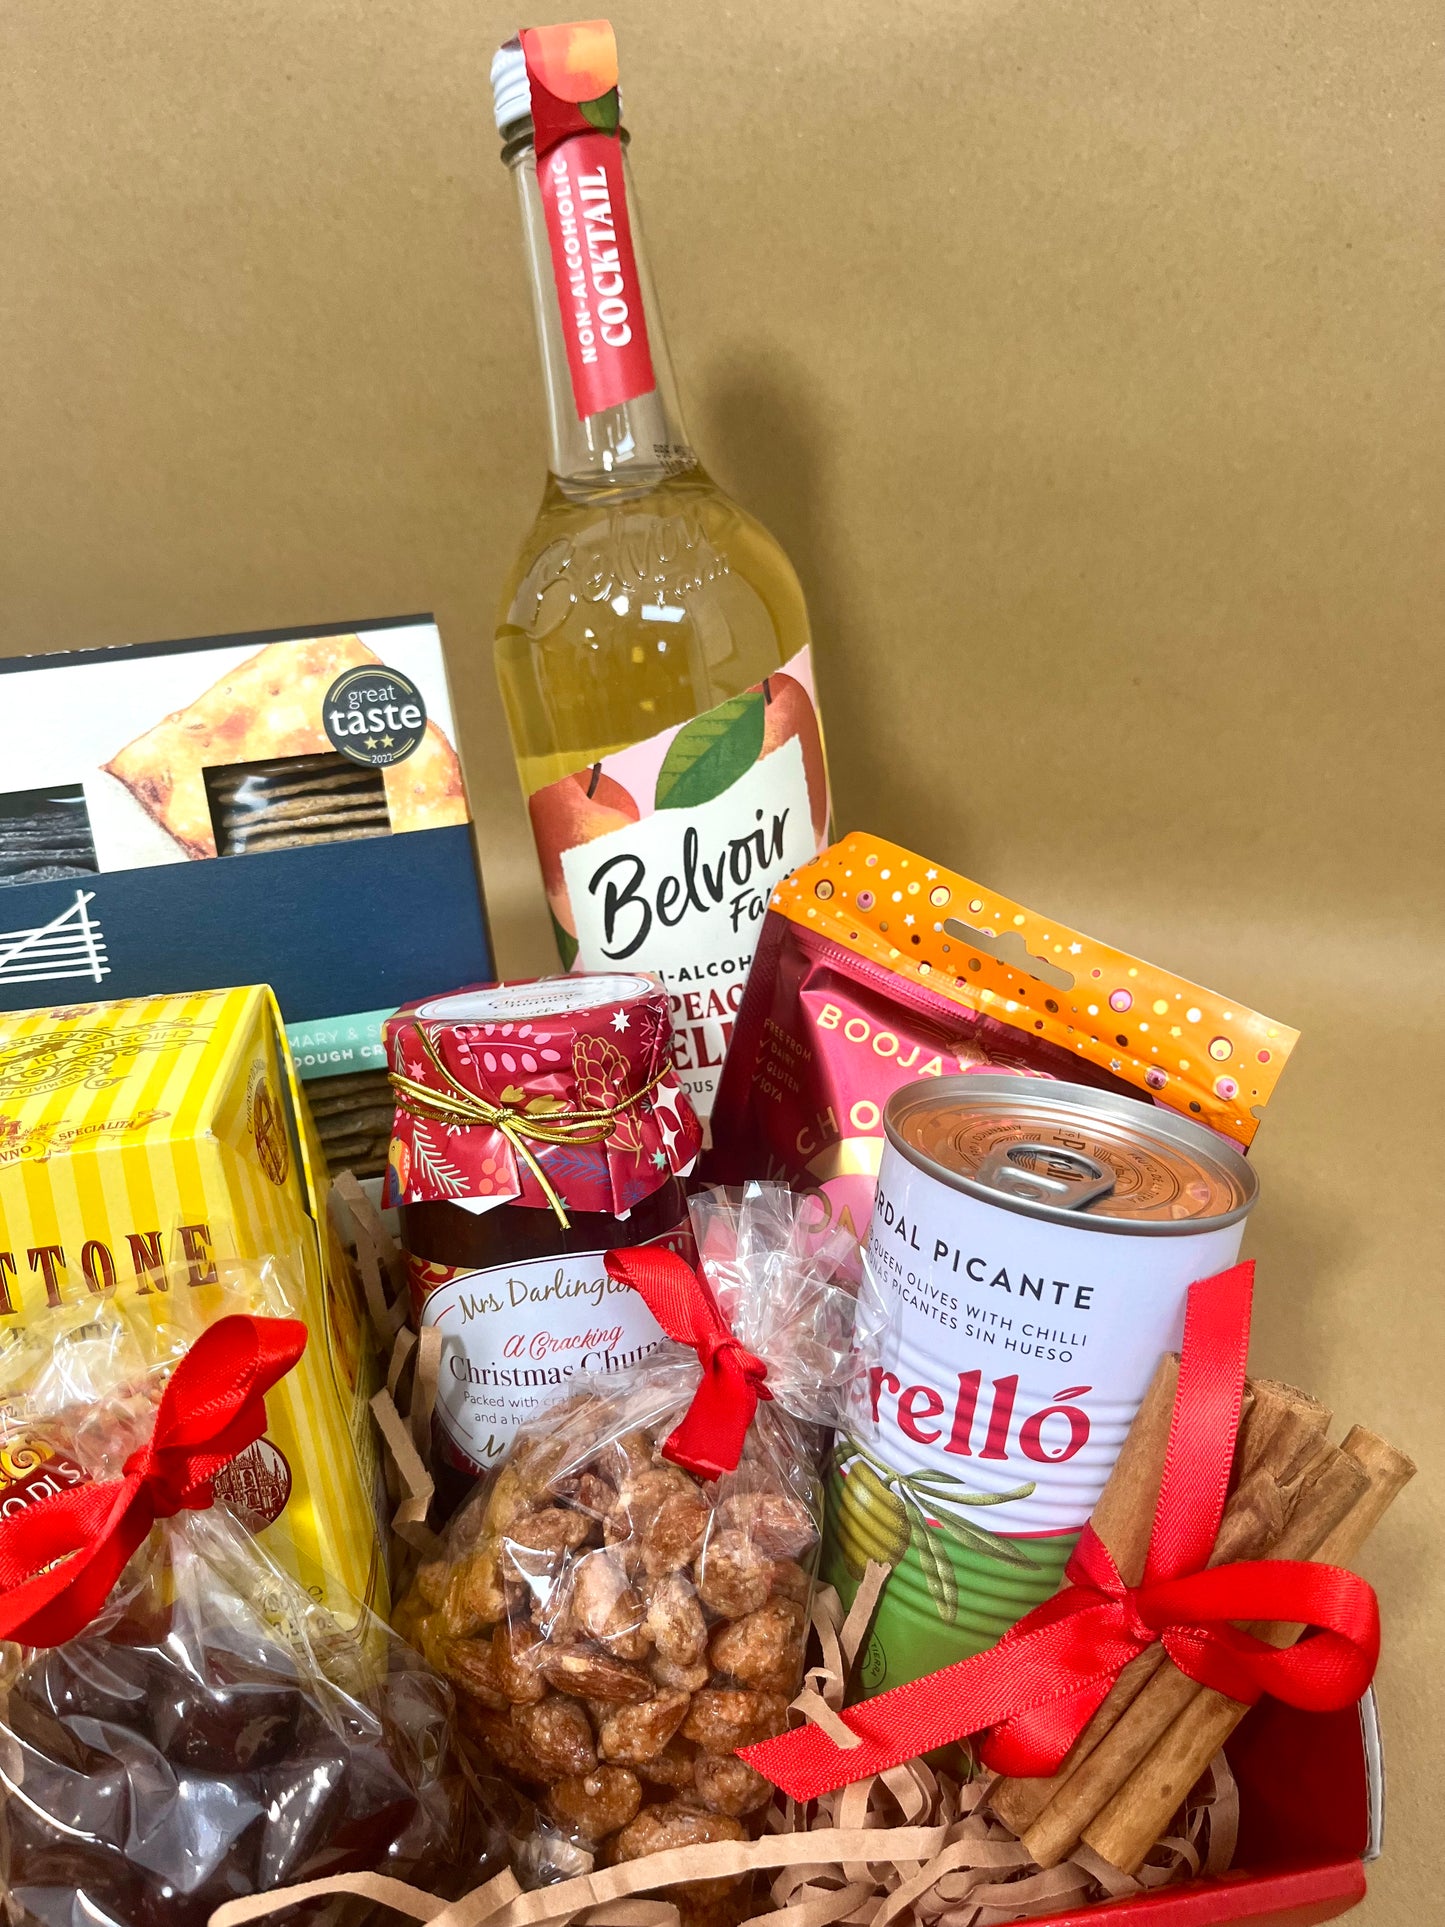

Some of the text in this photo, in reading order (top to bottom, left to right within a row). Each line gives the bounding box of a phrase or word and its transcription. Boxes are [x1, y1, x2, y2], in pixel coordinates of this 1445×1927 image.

[551, 160, 598, 365] NON-ALCOHOLIC
[577, 165, 632, 347] COCKTAIL
[348, 684, 397, 709] great
[329, 703, 422, 736] taste
[371, 753, 394, 763] 2022
[589, 808, 790, 960] Belvoir
[73, 1029, 194, 1055] CHIOSTRO
[347, 1027, 358, 1040] &
[764, 1018, 812, 1062] FREE FROM
[34, 1052, 59, 1065] DI
[293, 1049, 353, 1068] DOUGH
[770, 1042, 795, 1066] DAIRY
[759, 1078, 783, 1103] SOYA
[766, 1061, 799, 1093] GLUTEN
[933, 1239, 1094, 1310] PICANTE
[458, 1293, 504, 1324] Mrs
[874, 1238, 1087, 1347] QUEEN OLIVES WITH CHILLI
[891, 1278, 958, 1330] PICANTES
[965, 1324, 995, 1345] SIN
[1004, 1337, 1073, 1363] HUESO
[503, 1325, 624, 1360] A Cracking
[450, 1355, 574, 1387] Christmas
[464, 1391, 505, 1408] Packed
[509, 1396, 538, 1408] with
[475, 1412, 497, 1425] and
[501, 1416, 508, 1425] a
[26, 1474, 63, 1501] DI
[58, 1461, 88, 1484] S
